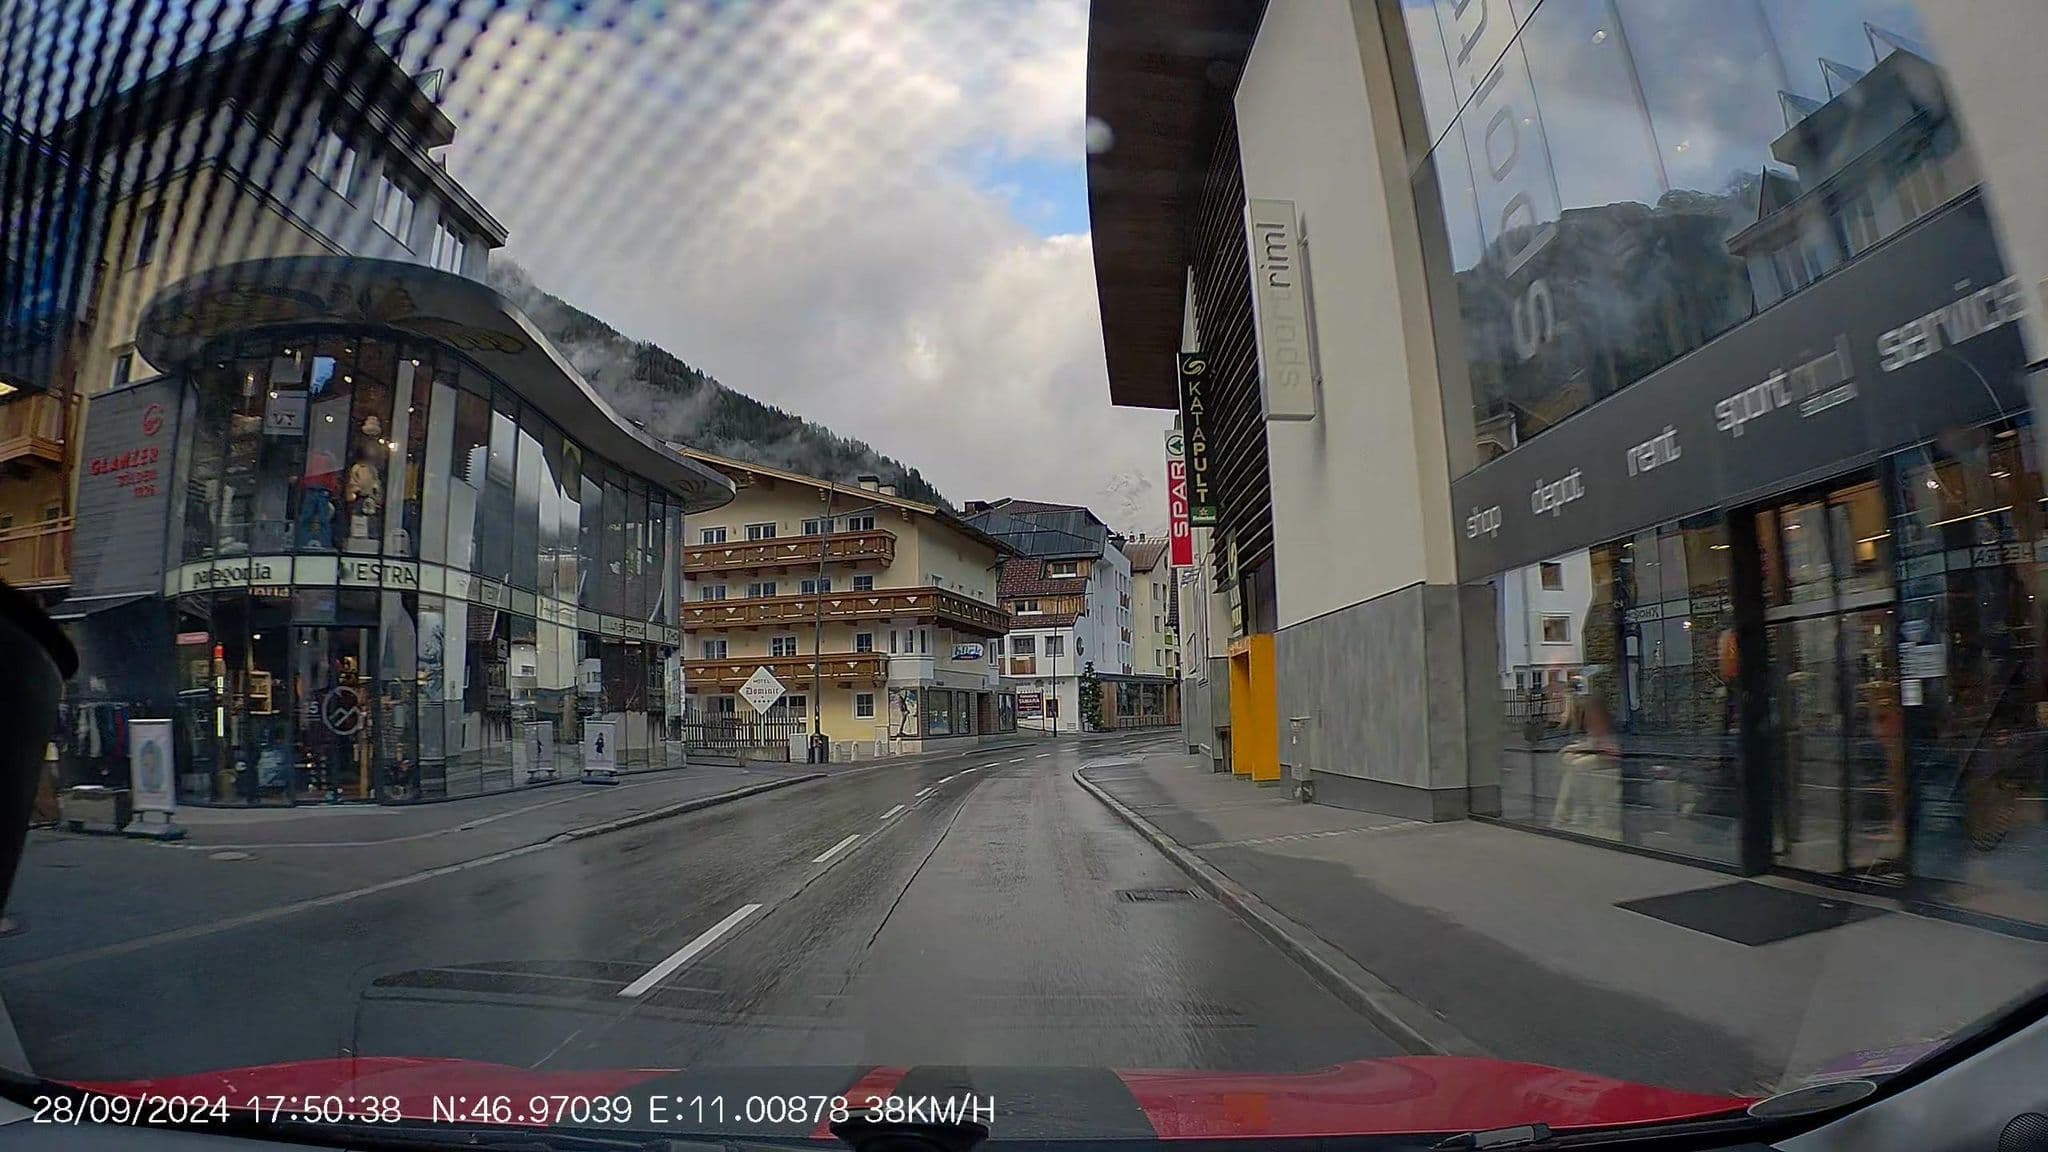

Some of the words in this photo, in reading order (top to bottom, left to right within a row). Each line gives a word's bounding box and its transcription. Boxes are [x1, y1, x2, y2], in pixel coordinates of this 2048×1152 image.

[1877, 276, 2024, 372] service
[1189, 381, 1208, 503] KATAPULT
[1627, 424, 1682, 478] rent
[1171, 461, 1189, 538] SPAR
[1531, 467, 1585, 518] depot
[1466, 505, 1502, 539] shop
[192, 562, 272, 588] patagonia
